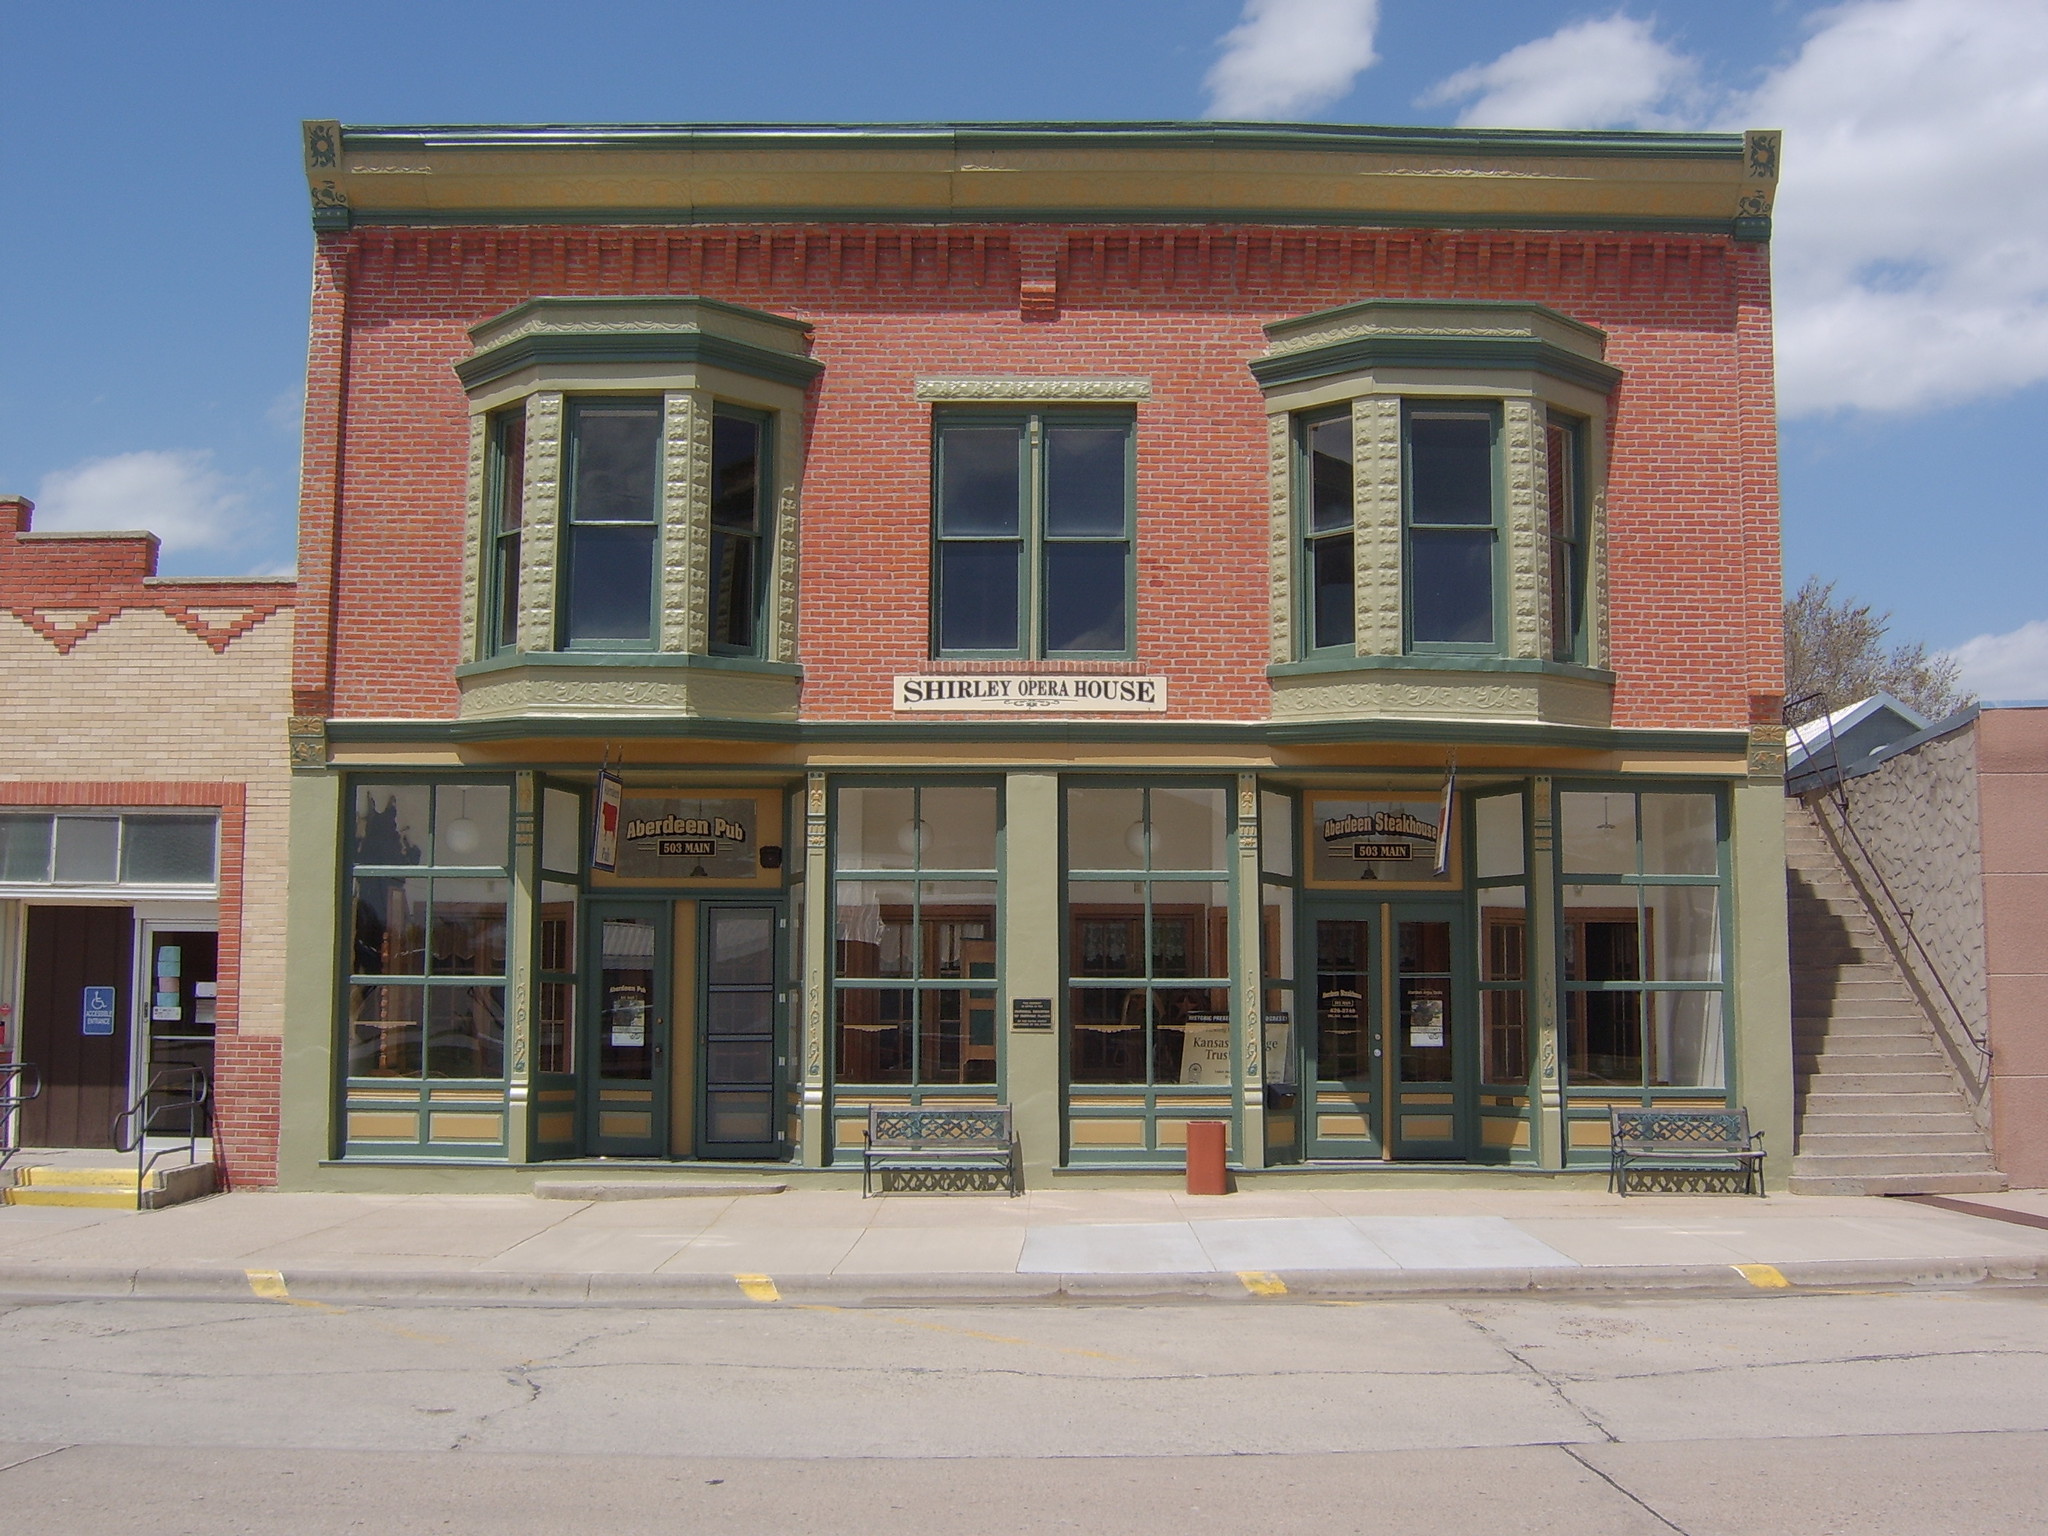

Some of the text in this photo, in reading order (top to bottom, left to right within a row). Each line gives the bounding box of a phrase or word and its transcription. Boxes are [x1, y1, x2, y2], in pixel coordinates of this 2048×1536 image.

[903, 680, 1156, 704] SHIRLEY OPERA HOUSE
[626, 815, 745, 842] Aberdeen Pub
[1324, 812, 1438, 841] Aberdeen Steakhouse
[663, 842, 712, 854] 503 MAIN
[1359, 846, 1407, 857] 503 MAIN
[1193, 1037, 1229, 1048] Kansas
